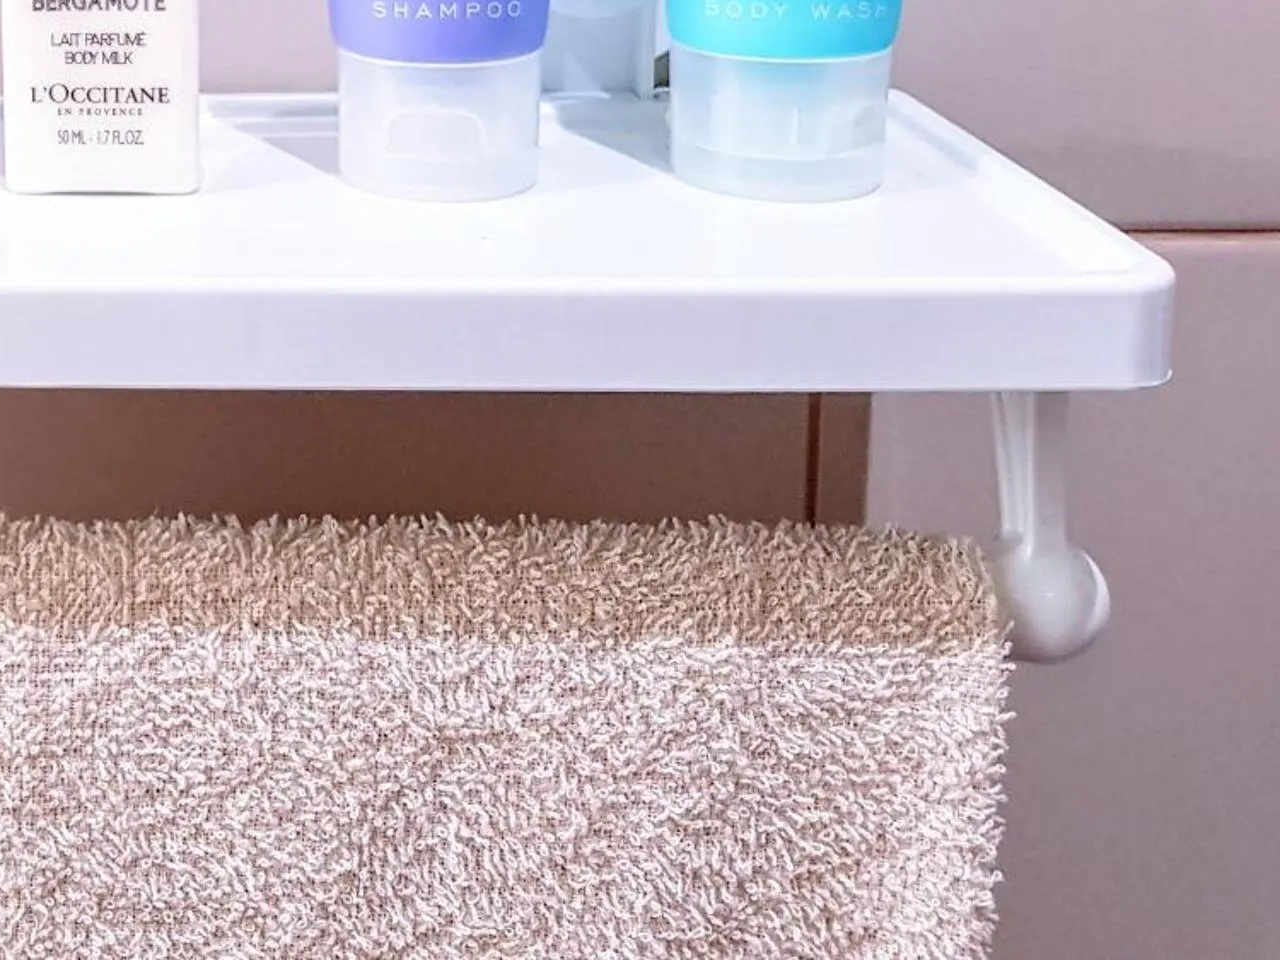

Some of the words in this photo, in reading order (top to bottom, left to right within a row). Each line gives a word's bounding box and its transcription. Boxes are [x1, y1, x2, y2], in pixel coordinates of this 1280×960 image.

[371, 0, 522, 20] SHAMPOO
[810, 0, 888, 22] WASH
[50, 32, 81, 47] LAIT
[64, 51, 99, 65] BODY
[101, 51, 134, 65] MILK
